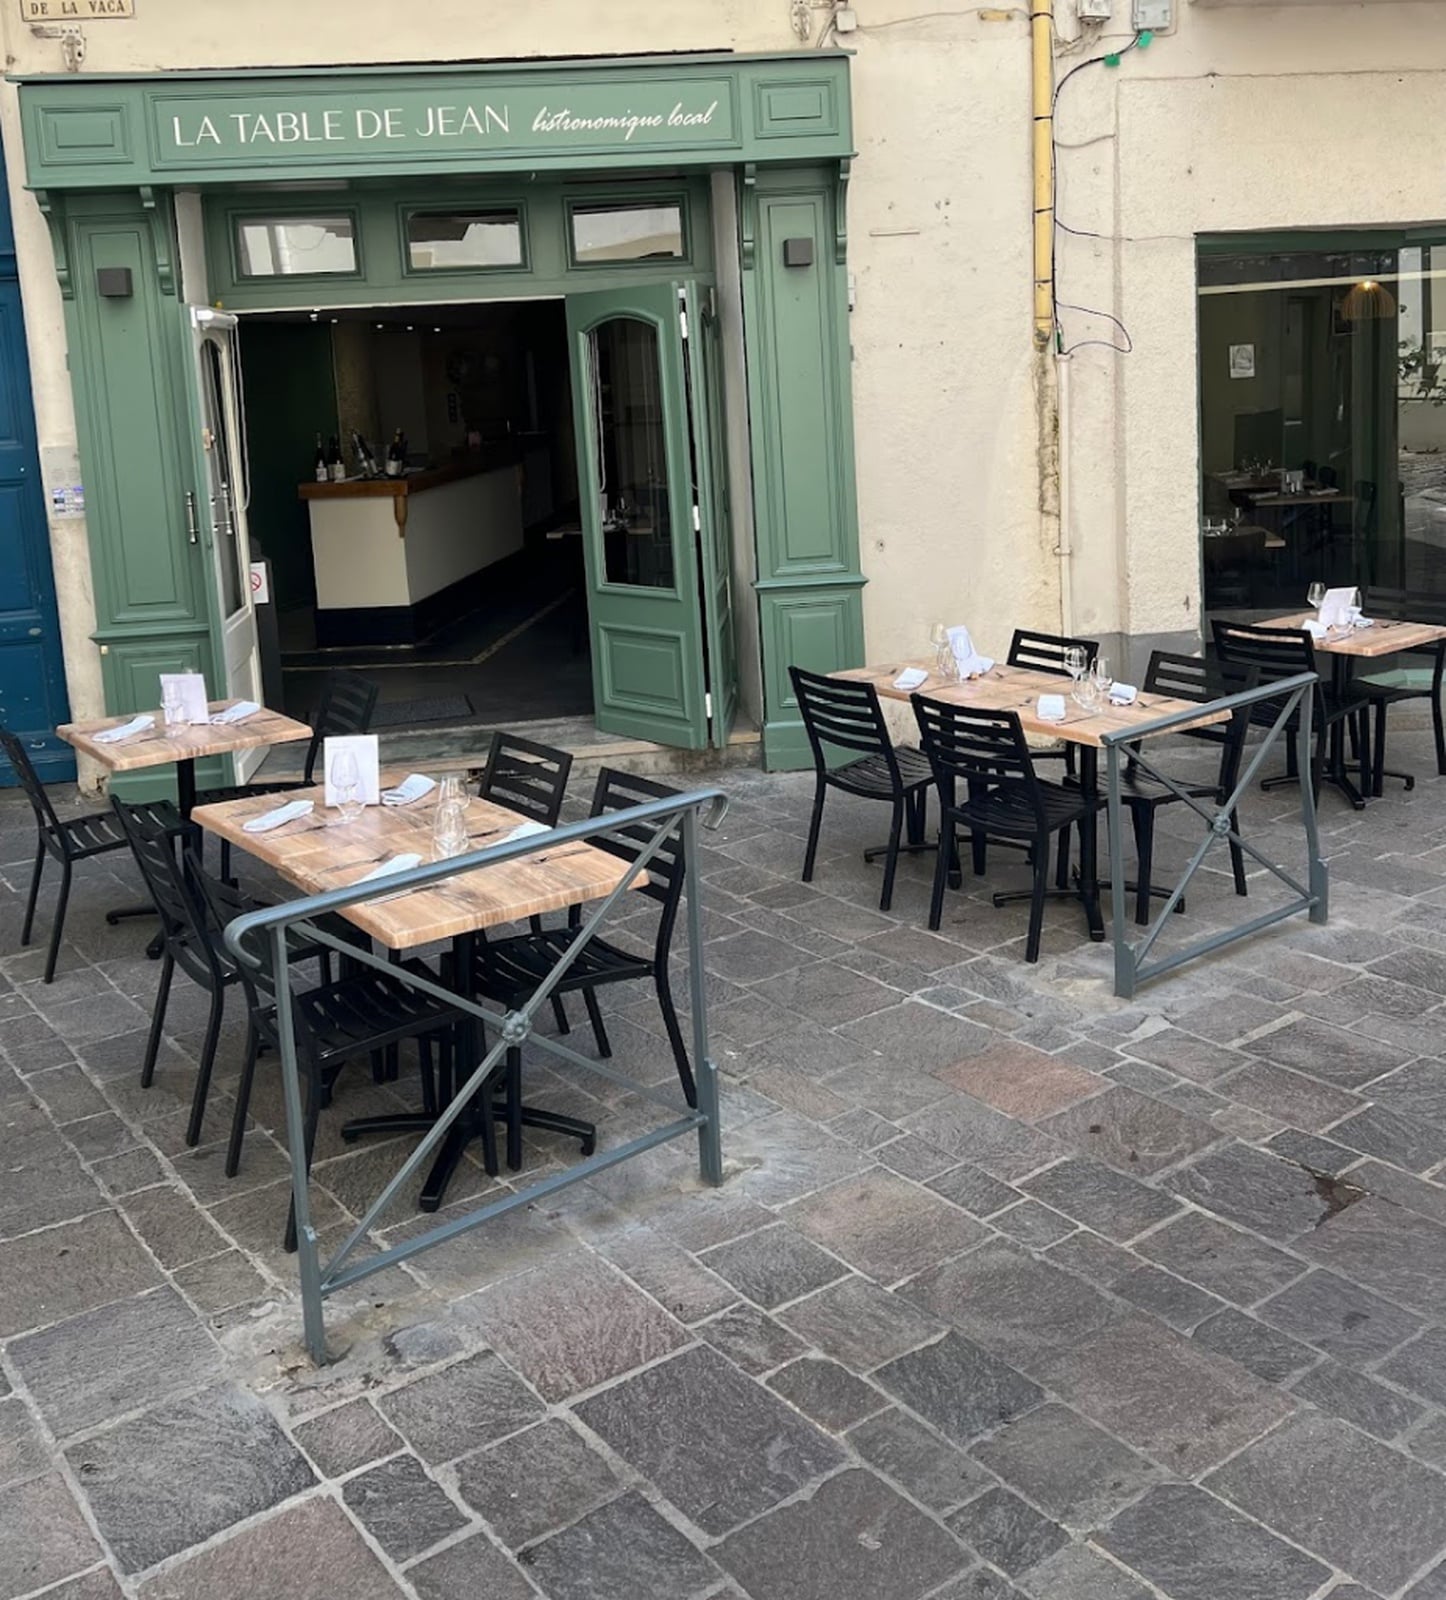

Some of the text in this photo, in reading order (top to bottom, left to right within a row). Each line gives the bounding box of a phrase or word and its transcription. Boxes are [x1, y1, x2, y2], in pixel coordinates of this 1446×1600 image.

[31, 0, 125, 15] DE LA VACA
[173, 105, 510, 146] LA TABLE DE JEAN
[532, 101, 718, 141] bistronomique local
